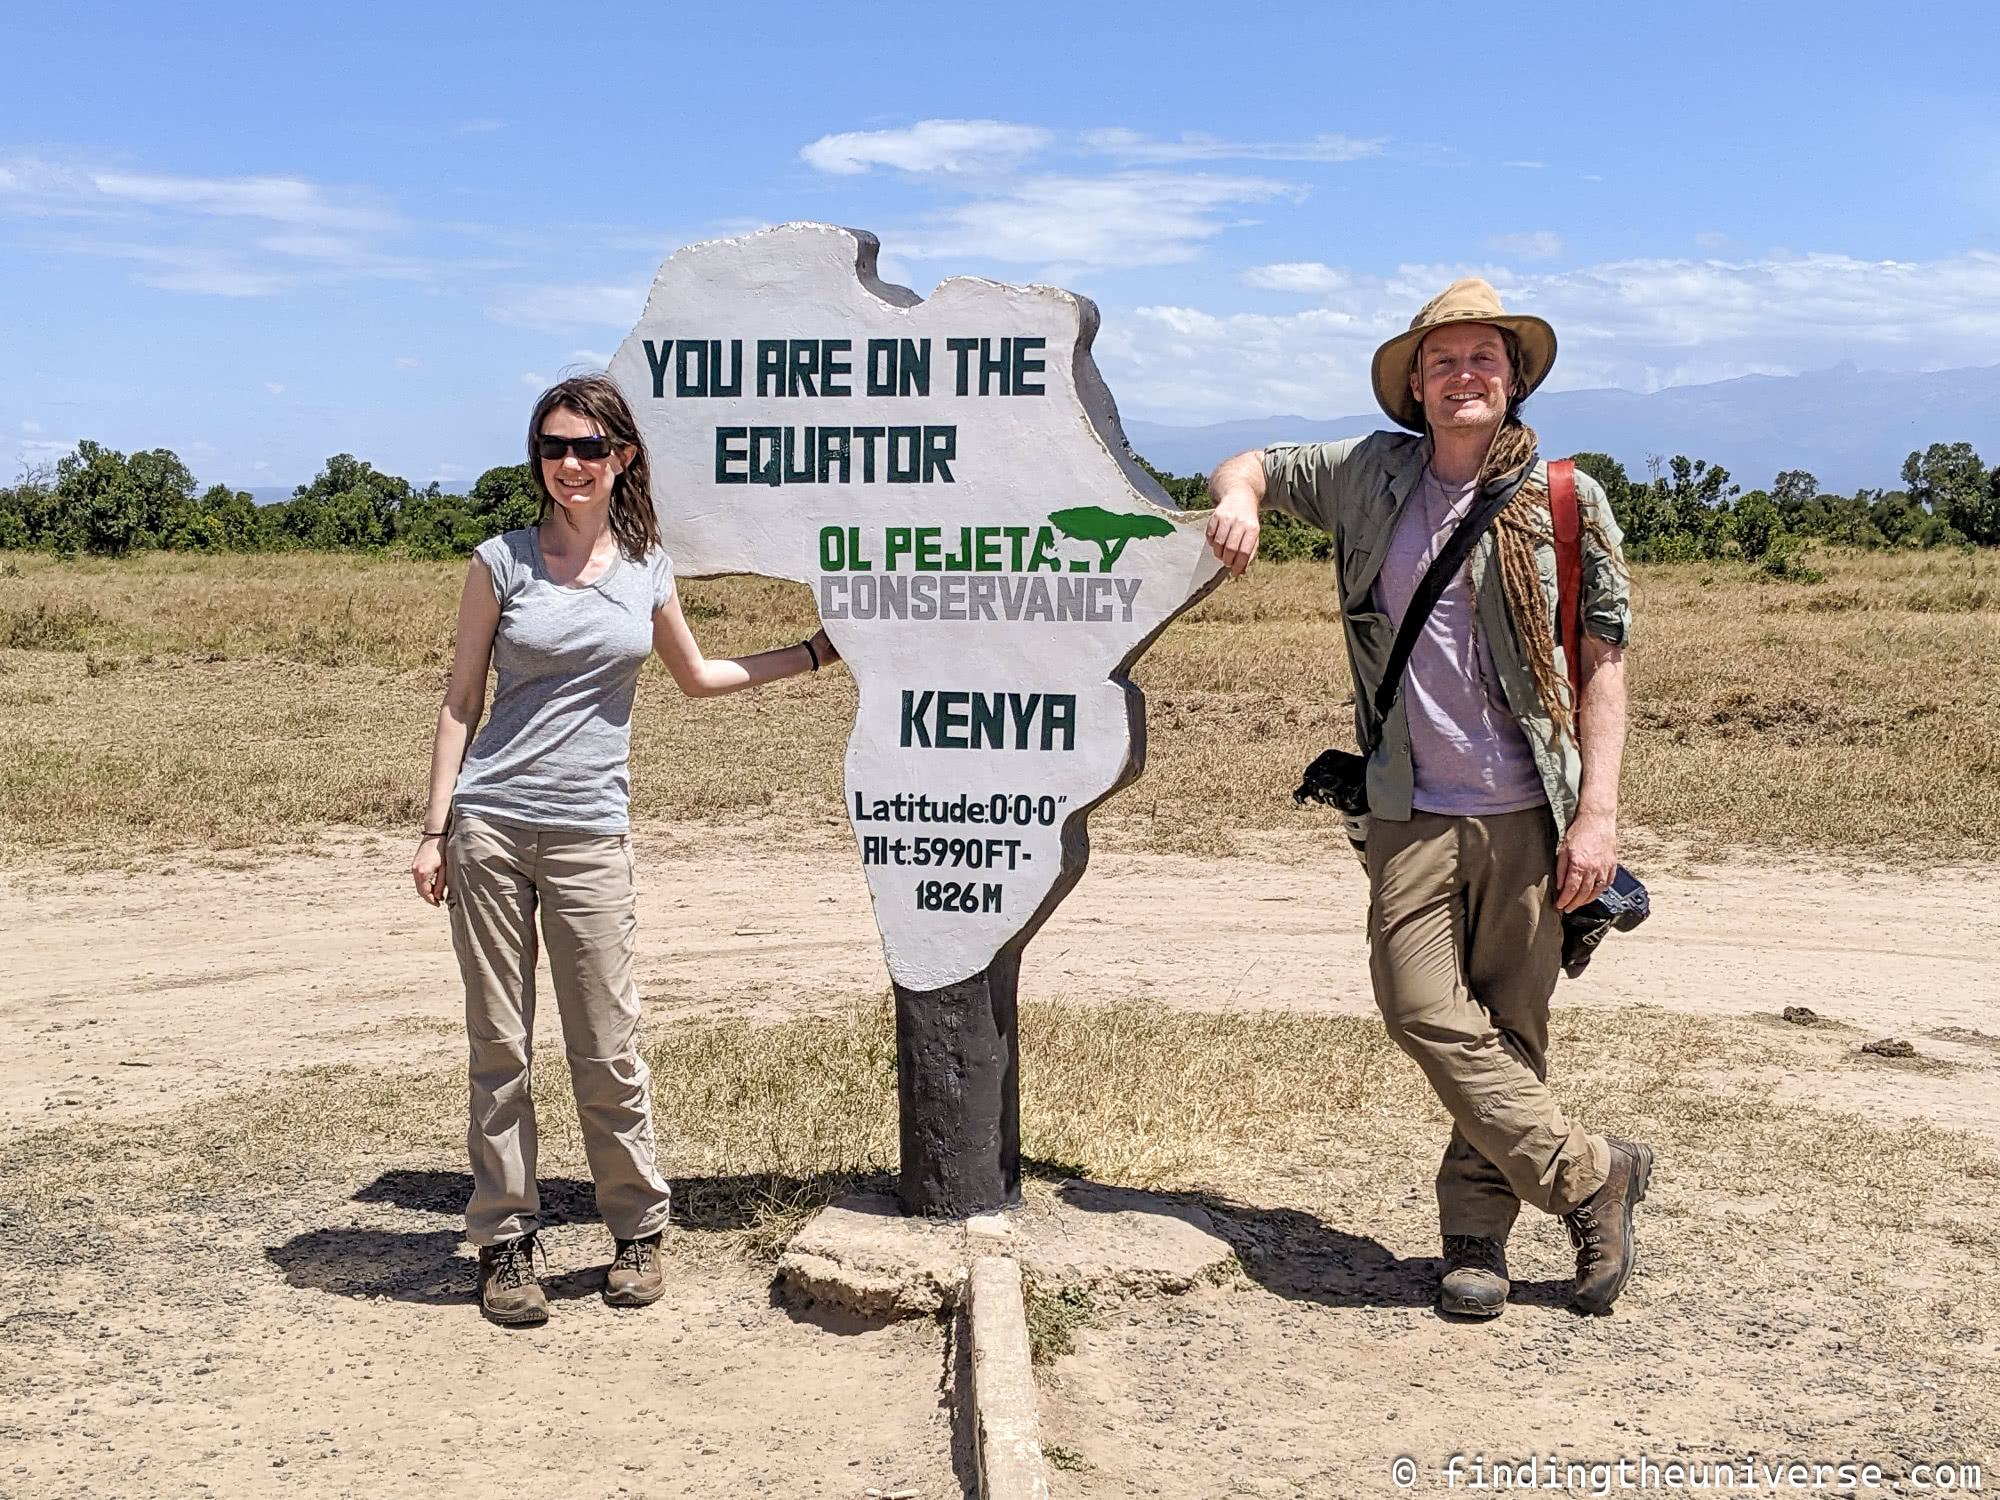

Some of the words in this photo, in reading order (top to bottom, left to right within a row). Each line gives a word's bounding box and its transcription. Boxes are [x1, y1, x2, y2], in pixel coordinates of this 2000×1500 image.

[643, 339, 742, 398] YOU
[756, 339, 852, 397] ARE
[867, 338, 931, 397] ON
[947, 337, 1046, 396] THE
[715, 425, 957, 487] EQUATOR
[819, 526, 872, 572] OL
[885, 526, 1062, 573] PEJETA
[821, 576, 1143, 622] CONSERVANCY
[900, 690, 1076, 750] KENYA
